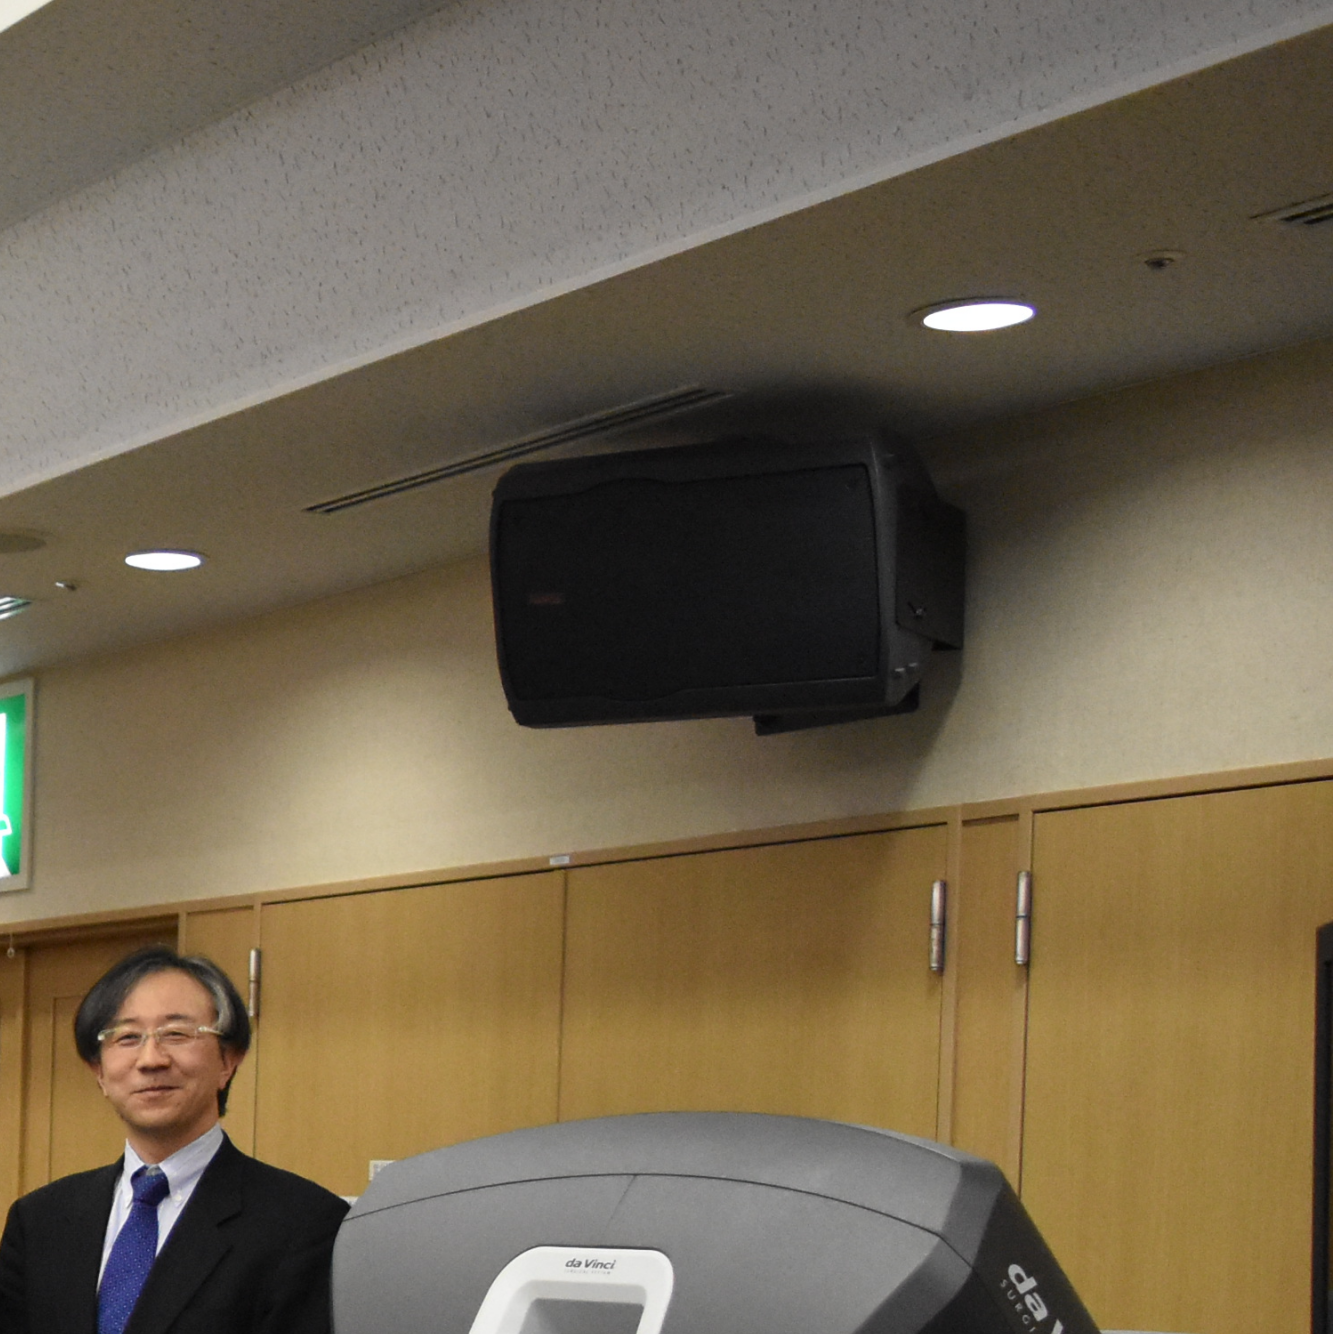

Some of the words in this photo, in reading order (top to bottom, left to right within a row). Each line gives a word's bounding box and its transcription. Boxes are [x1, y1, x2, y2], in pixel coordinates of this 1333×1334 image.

[565, 1258, 583, 1268] da
[584, 1258, 617, 1270] Vinci
[1007, 1263, 1049, 1322] da
